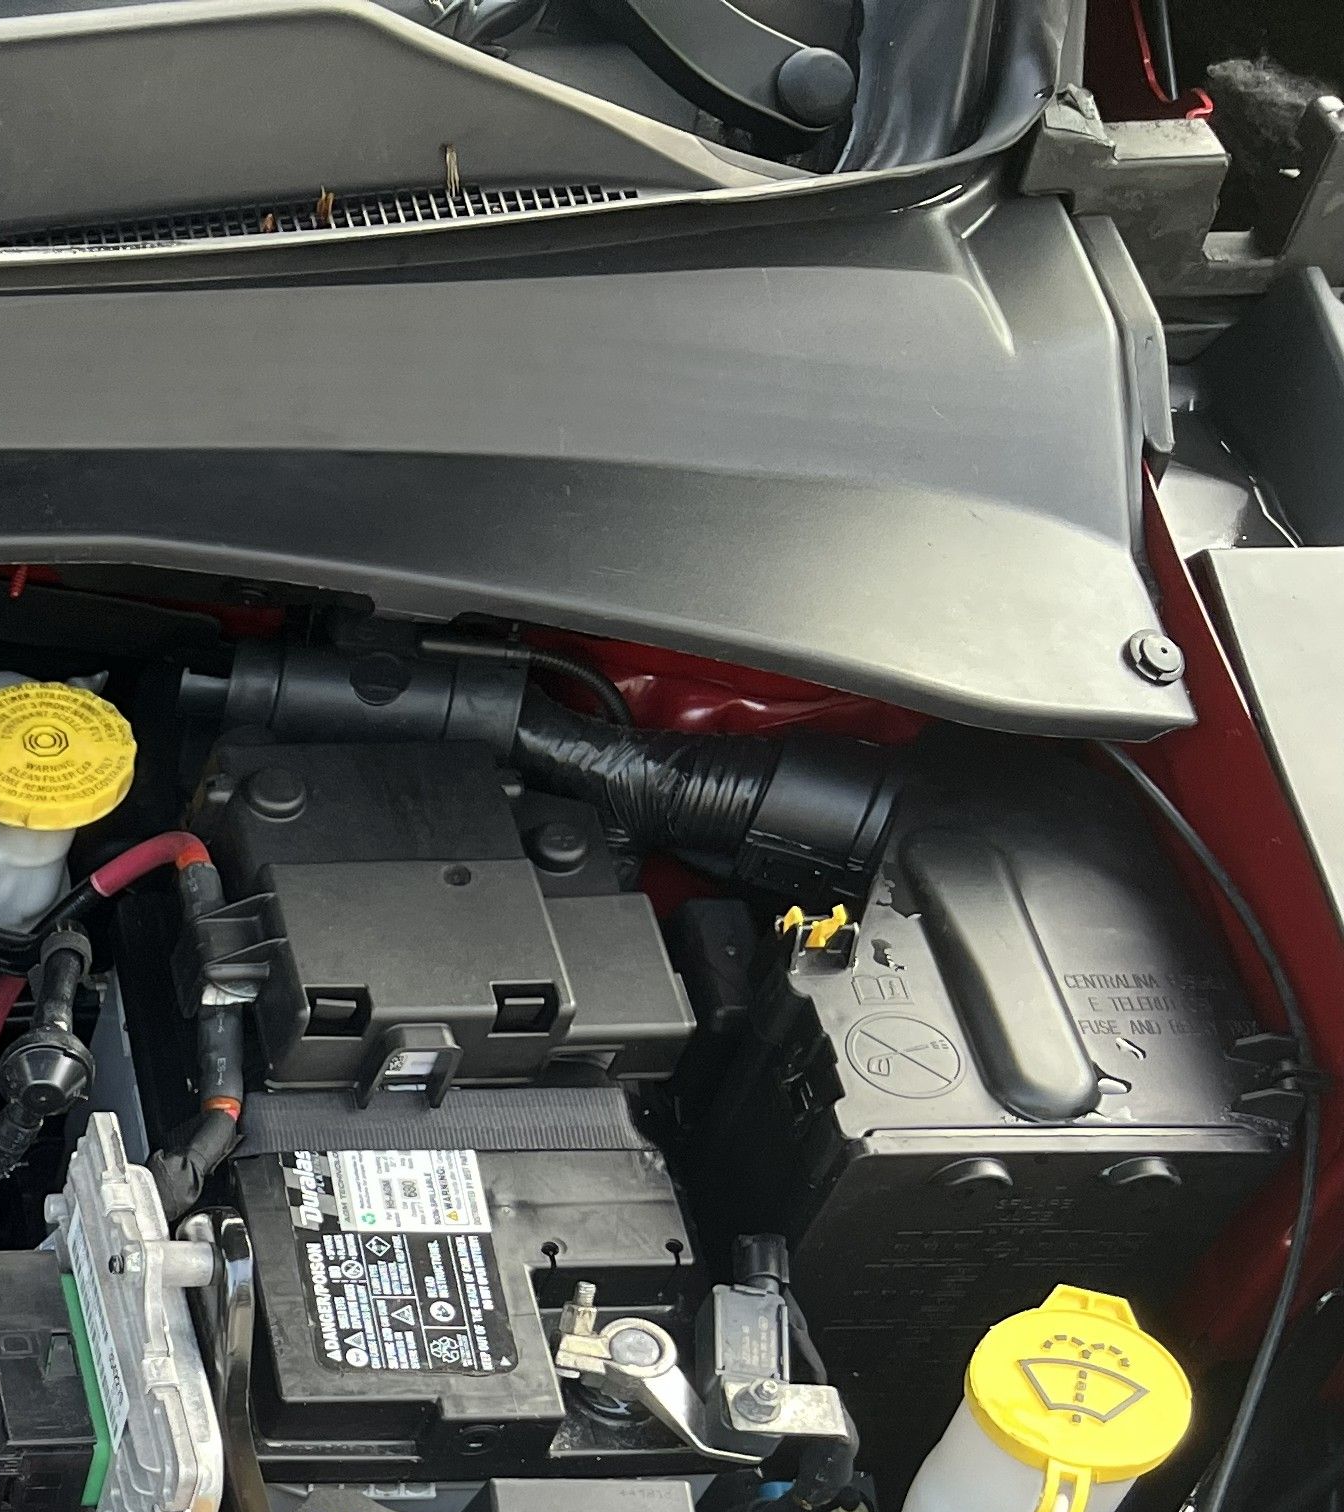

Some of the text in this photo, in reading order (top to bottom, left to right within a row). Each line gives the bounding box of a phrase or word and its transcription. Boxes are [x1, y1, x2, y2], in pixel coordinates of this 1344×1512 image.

[26, 759, 75, 772] WARNING
[8, 766, 41, 782] CLEAN
[1064, 974, 1158, 989] CENTRALINA
[1078, 1019, 1121, 1035] FUSE
[1130, 1020, 1161, 1035] AND
[330, 1151, 346, 1200] TECHNOLO
[292, 1151, 323, 1224] Duralas
[305, 1242, 339, 1349] DANGER/POISON
